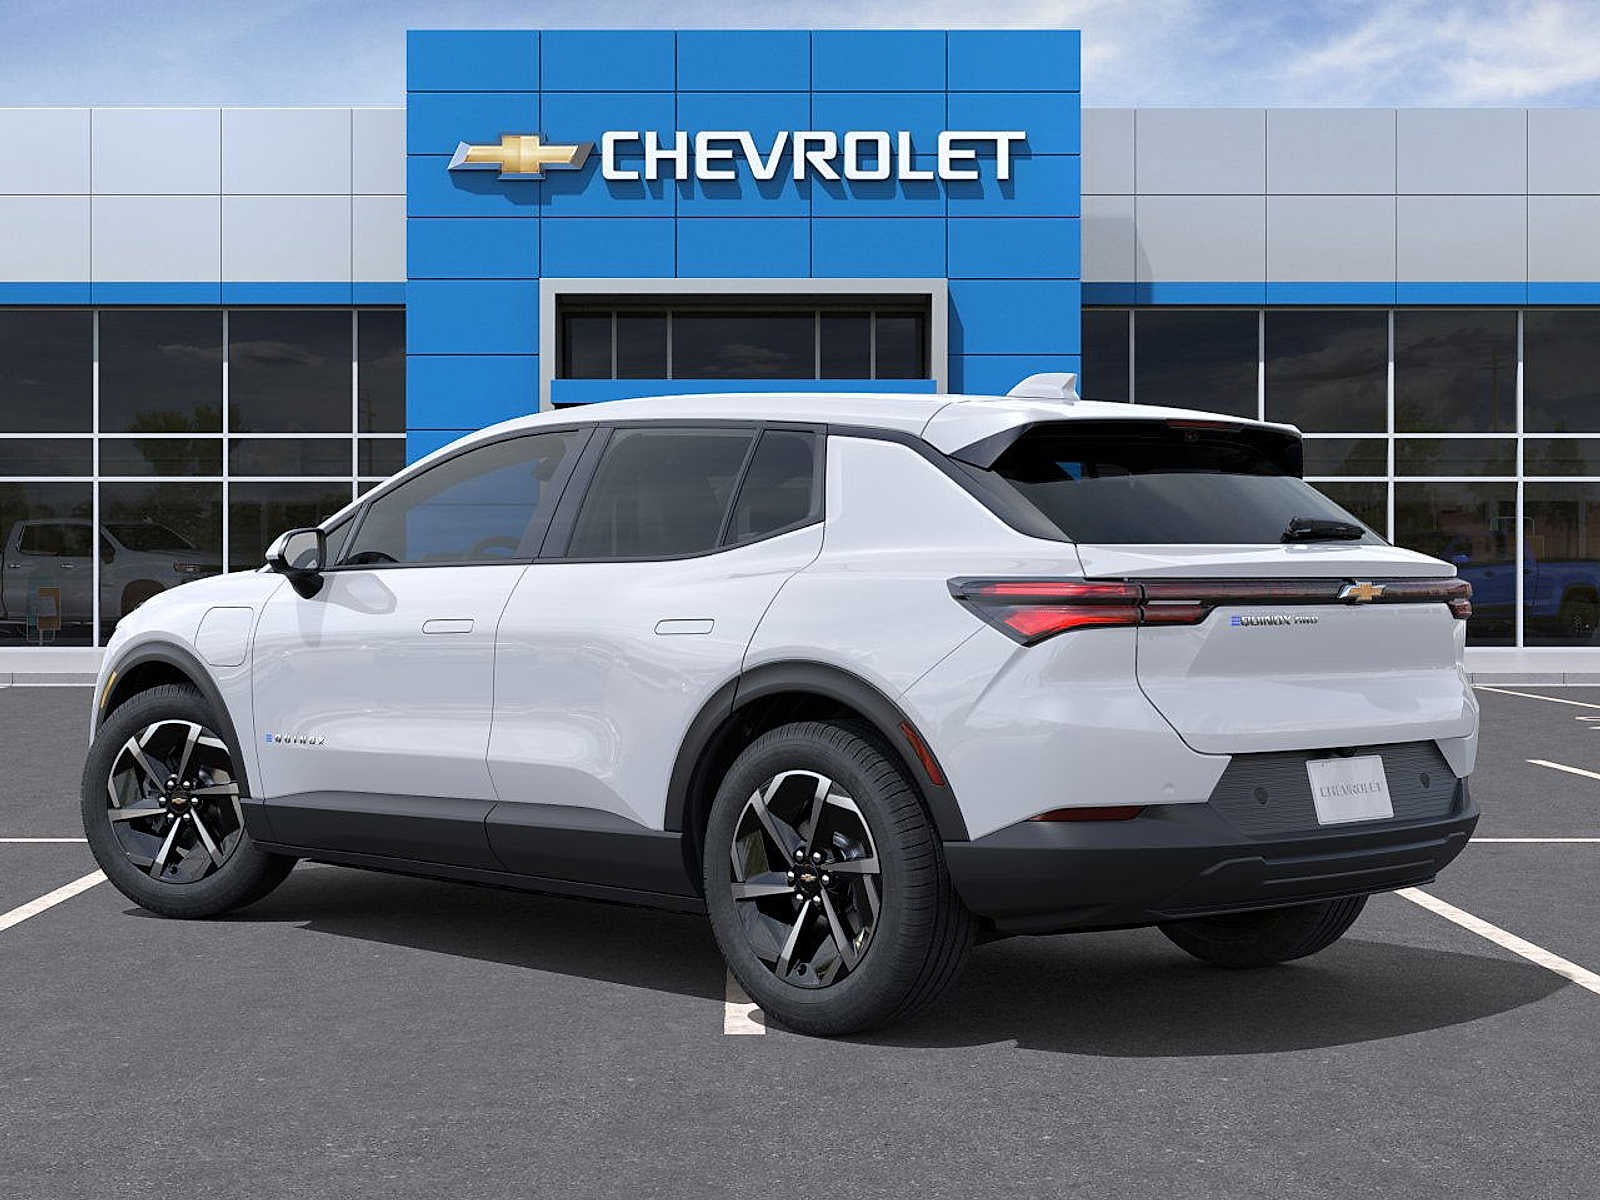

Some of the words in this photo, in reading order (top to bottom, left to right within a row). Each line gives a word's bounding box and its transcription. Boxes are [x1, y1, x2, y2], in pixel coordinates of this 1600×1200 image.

[601, 130, 1026, 181] CHEVROLET
[1231, 615, 1291, 627] EQUINOX
[265, 733, 325, 745] EQUINOX
[1319, 781, 1381, 798] CHEVROLET
